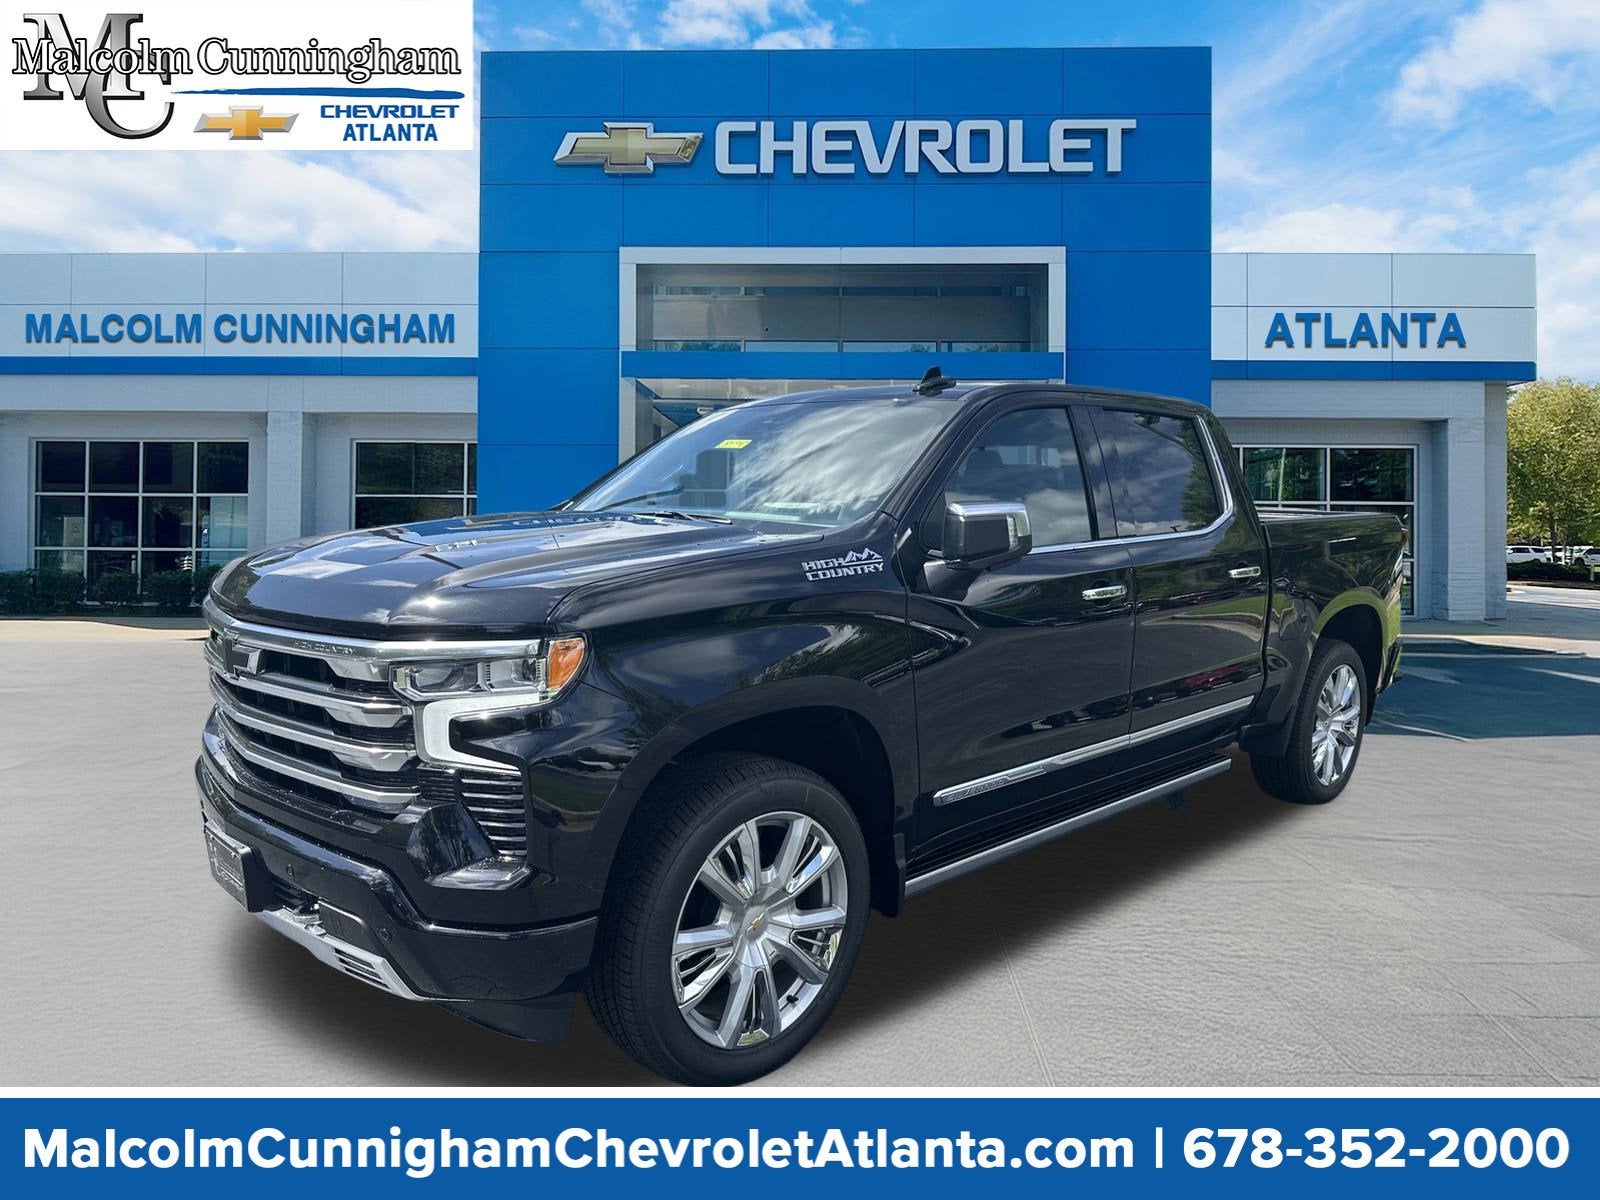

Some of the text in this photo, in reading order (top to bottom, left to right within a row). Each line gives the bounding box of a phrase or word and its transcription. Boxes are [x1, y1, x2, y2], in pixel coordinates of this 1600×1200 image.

[715, 118, 1137, 175] CHEVROLET
[25, 313, 456, 344] MALCOLM CUNNINGHAM
[1264, 312, 1468, 348] ATLANTA
[801, 557, 846, 571] HIGH
[806, 562, 884, 582] COUNTRY
